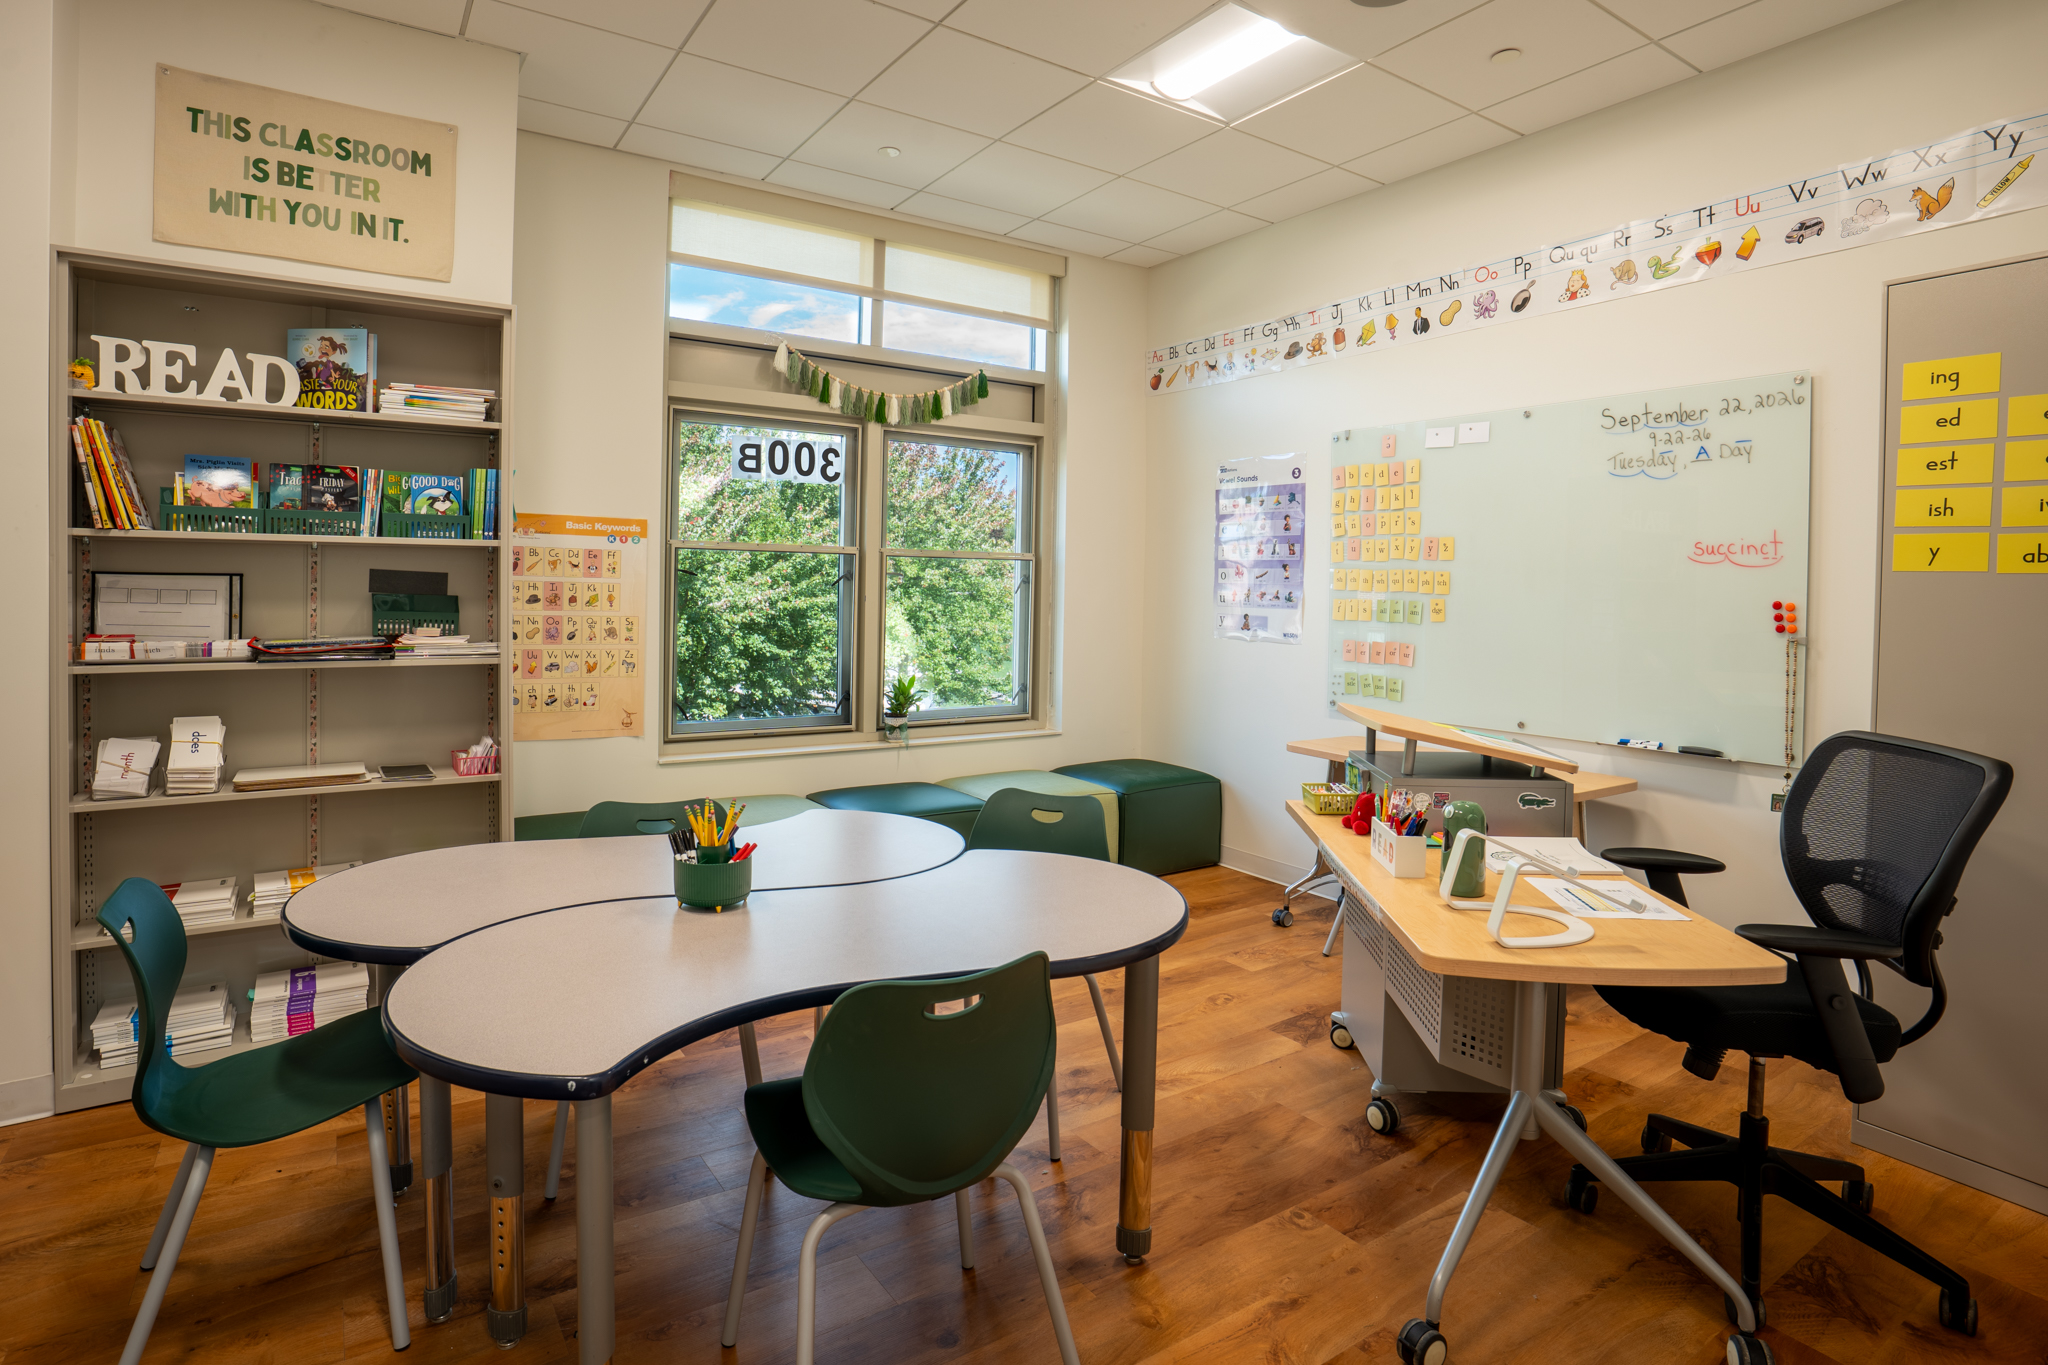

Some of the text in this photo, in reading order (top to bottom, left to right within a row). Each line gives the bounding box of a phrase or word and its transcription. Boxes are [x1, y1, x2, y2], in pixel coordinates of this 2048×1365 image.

[186, 107, 432, 177] THIS CLASSROOM
[243, 156, 381, 203] IS BETTER
[1990, 177, 2010, 196] YELLOW
[209, 188, 409, 244] WITH YOU IN IT.
[1152, 124, 2024, 363] Aa Bb Cc Dd Ee Ff Gg Hh Ii Jj Kk Ll Mm Nn Oo Pp Qu qu Rr Ss Tt Uu Vv Ww Xx Yy
[91, 335, 300, 408] READ
[300, 379, 357, 393] ASTE YOUR
[1930, 372, 1960, 392] ing
[296, 391, 357, 410] WORDS
[1601, 402, 1708, 432] September
[1936, 407, 1961, 428] ed
[1649, 428, 1711, 446] 9-22-26
[1696, 446, 1710, 460] A
[1719, 443, 1752, 464] Day
[1926, 451, 1958, 471] est
[280, 472, 302, 485] Trac
[320, 478, 344, 487] FRIDAY
[412, 476, 438, 489] GOOD
[1928, 498, 1954, 516] ish
[566, 521, 641, 533] Basic Keywords
[1694, 529, 1784, 557] succinct
[529, 548, 616, 560] Bb Cc Dd Ee Ff
[1928, 547, 1940, 566] y
[528, 583, 614, 594] Hh Ii Jj Kk Ll
[1392, 578, 1400, 586] qu
[1422, 579, 1430, 587] ph
[527, 618, 538, 626] Nn
[547, 617, 560, 626] Oo
[568, 618, 577, 628] Pp
[606, 618, 614, 626] Rr
[626, 618, 634, 626] Ss
[527, 652, 538, 660] Uu
[606, 652, 615, 662] Yy
[528, 686, 536, 694] ch
[548, 686, 556, 694] sh
[586, 684, 594, 692] ck
[191, 731, 206, 754] does
[1372, 828, 1394, 864] READ
